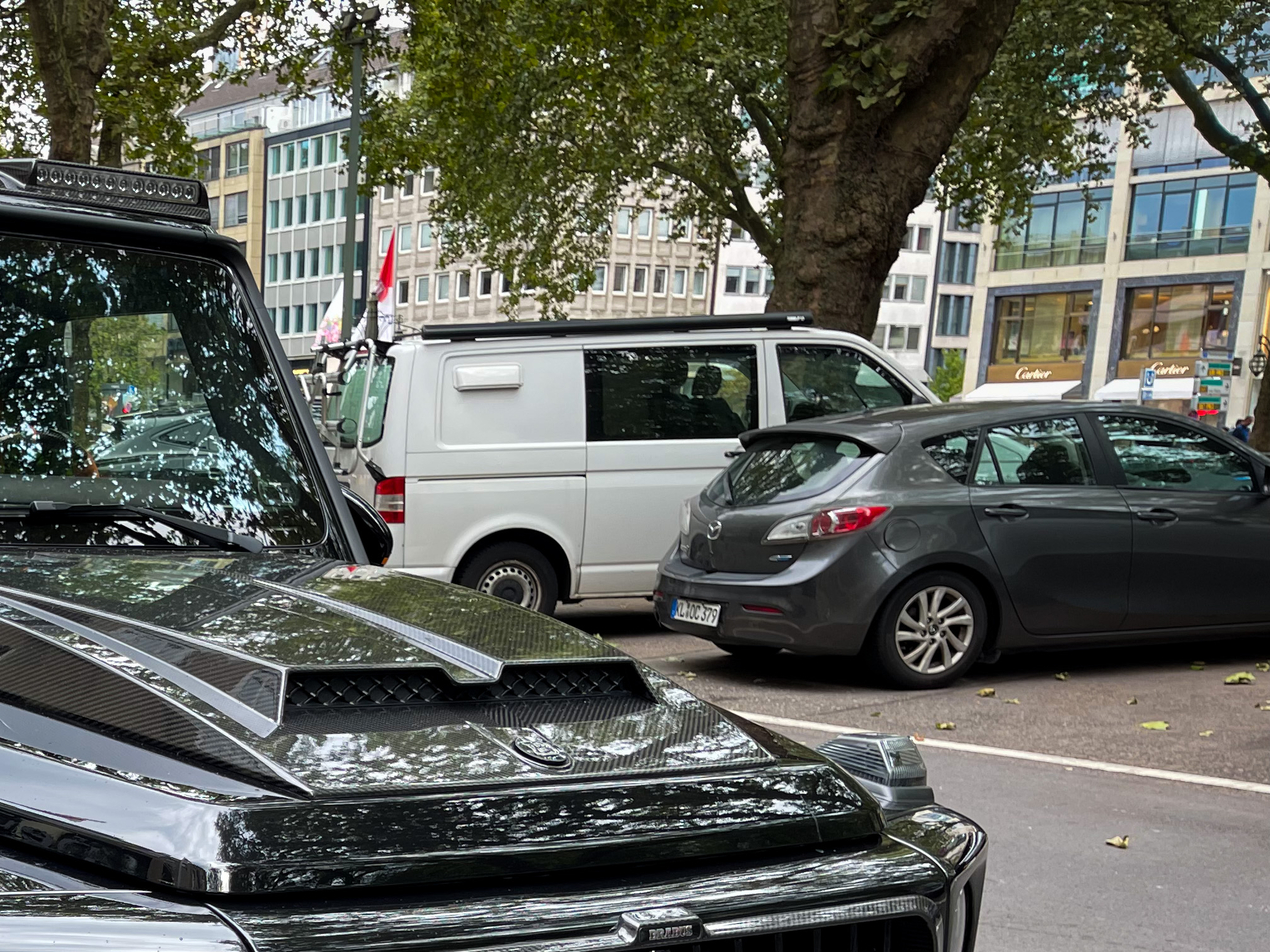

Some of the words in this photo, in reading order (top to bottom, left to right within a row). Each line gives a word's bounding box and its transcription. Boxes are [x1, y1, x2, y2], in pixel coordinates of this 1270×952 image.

[1014, 366, 1052, 380] Cartier
[1149, 361, 1189, 375] Cartier
[700, 605, 718, 624] 379
[648, 924, 693, 941] BRABUS
